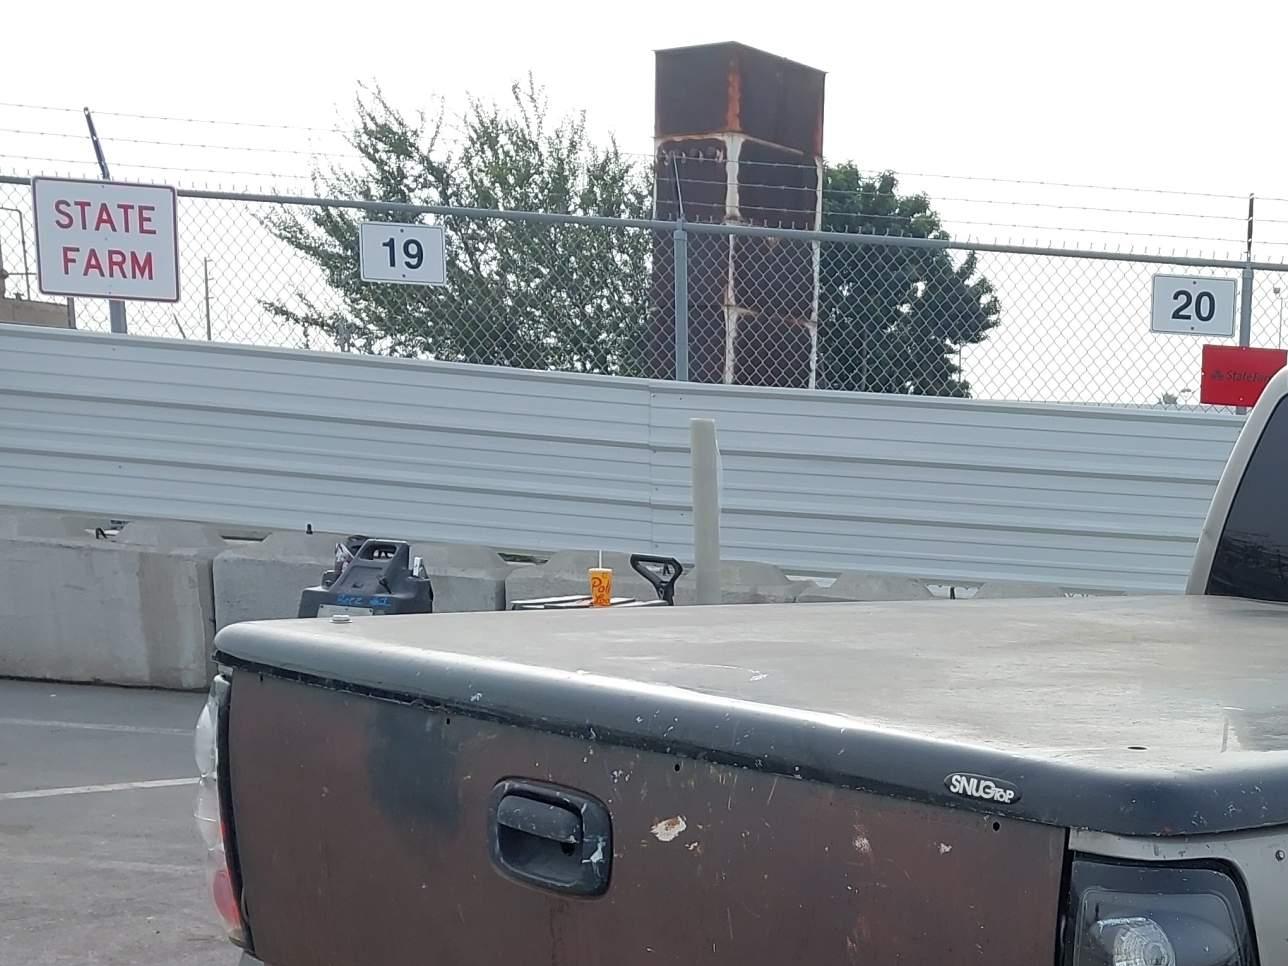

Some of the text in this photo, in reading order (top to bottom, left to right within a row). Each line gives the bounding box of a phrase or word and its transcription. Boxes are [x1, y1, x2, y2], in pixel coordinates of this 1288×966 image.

[54, 199, 157, 235] STATE
[62, 246, 154, 281] FARM
[382, 238, 424, 270] 19
[1171, 290, 1216, 322] 20
